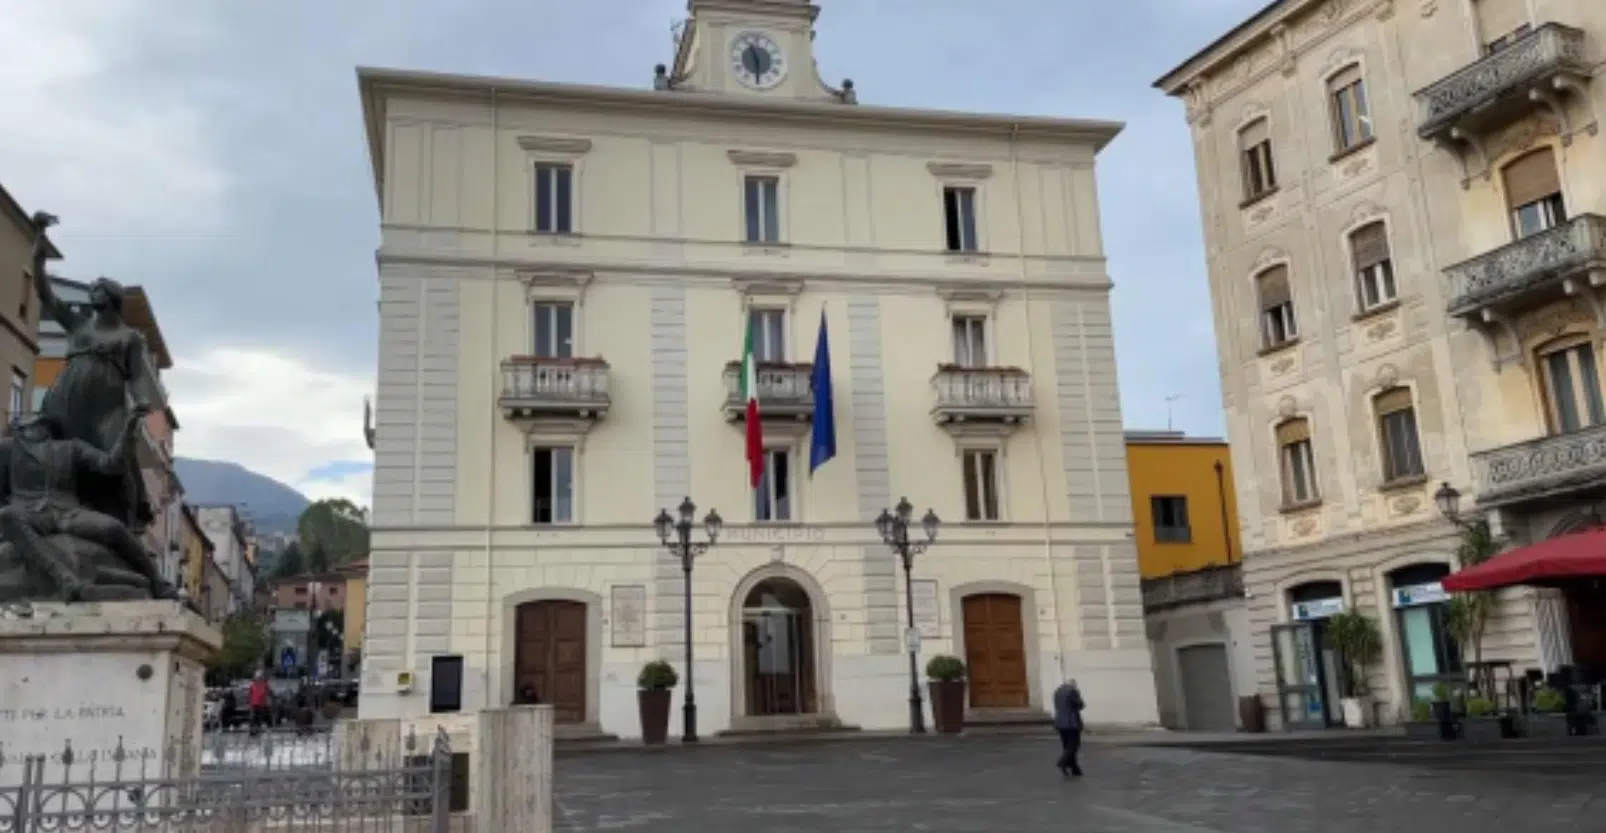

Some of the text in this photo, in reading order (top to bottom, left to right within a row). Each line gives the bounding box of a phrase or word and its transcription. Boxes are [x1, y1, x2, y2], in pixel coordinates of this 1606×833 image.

[726, 527, 825, 541] MUNICIPIO
[22, 707, 48, 721] PER
[54, 706, 76, 720] LA
[79, 706, 125, 718] PATRIA
